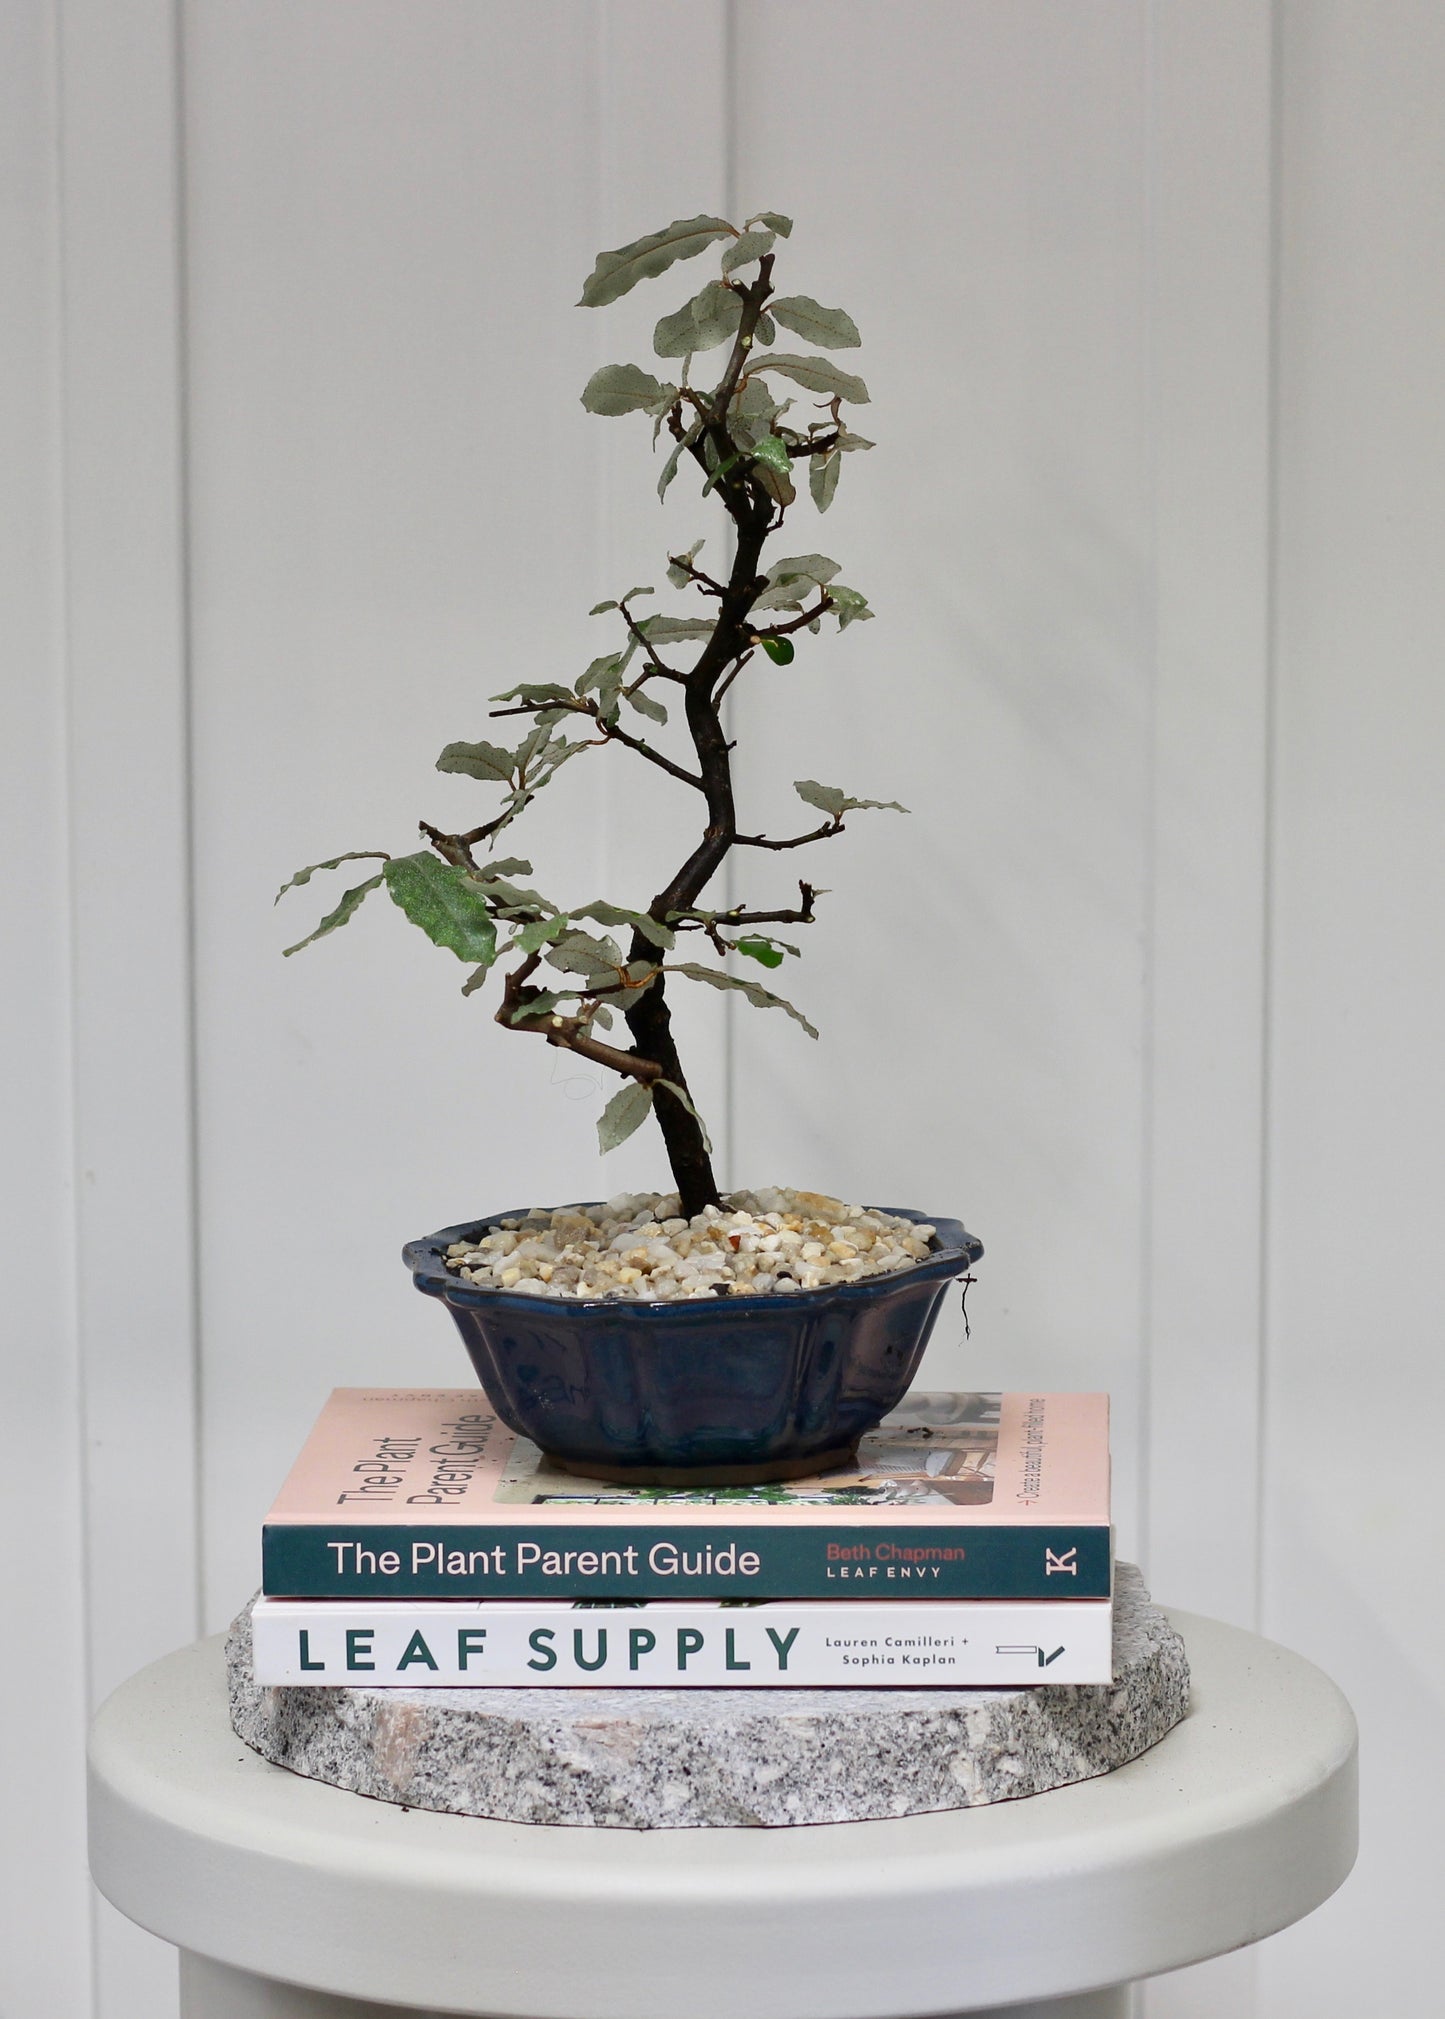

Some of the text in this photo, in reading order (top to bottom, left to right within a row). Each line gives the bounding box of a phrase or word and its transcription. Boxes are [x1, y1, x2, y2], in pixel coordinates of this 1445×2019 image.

[429, 1414, 497, 1456] Guide
[337, 1437, 422, 1504] The Plant
[406, 1458, 479, 1504] Parent
[327, 1541, 760, 1575] The Plant Parent Guide
[826, 1543, 965, 1563] Beth Chapman
[826, 1567, 941, 1577] LEAF ENVY
[300, 1628, 800, 1672] LEAF SUPPLY
[826, 1637, 878, 1647] Lauren
[885, 1636, 955, 1647] Camilleri
[842, 1654, 956, 1667] Sophia Kaplan
